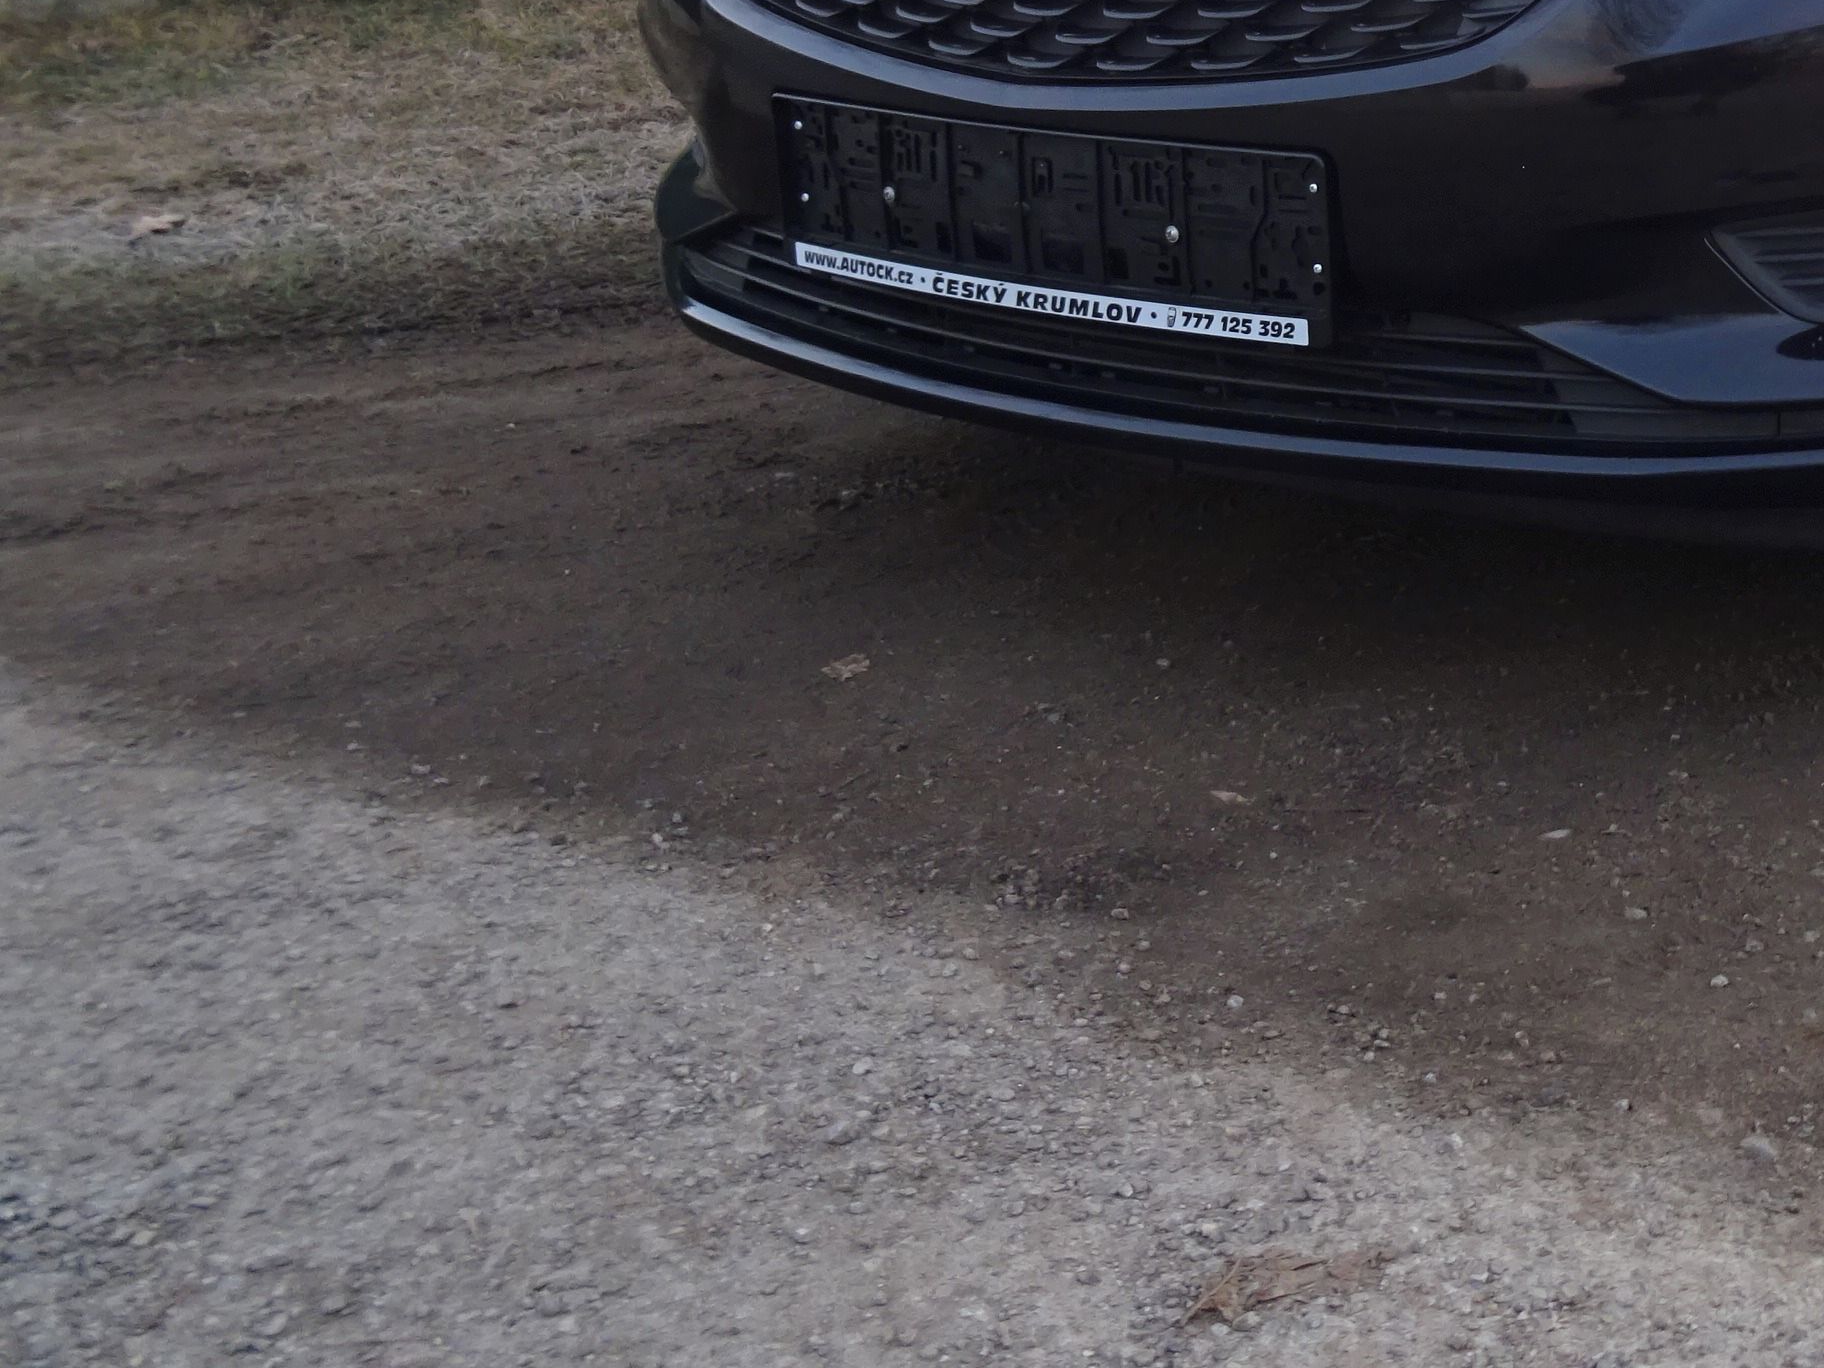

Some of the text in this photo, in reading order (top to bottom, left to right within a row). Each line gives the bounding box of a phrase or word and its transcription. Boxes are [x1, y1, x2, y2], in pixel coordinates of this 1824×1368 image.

[932, 272, 1007, 304] ČESKÝ
[1015, 290, 1142, 324] KRUMLOV
[1181, 311, 1215, 330] 777
[1220, 315, 1253, 335] 125
[1258, 320, 1296, 339] 392
